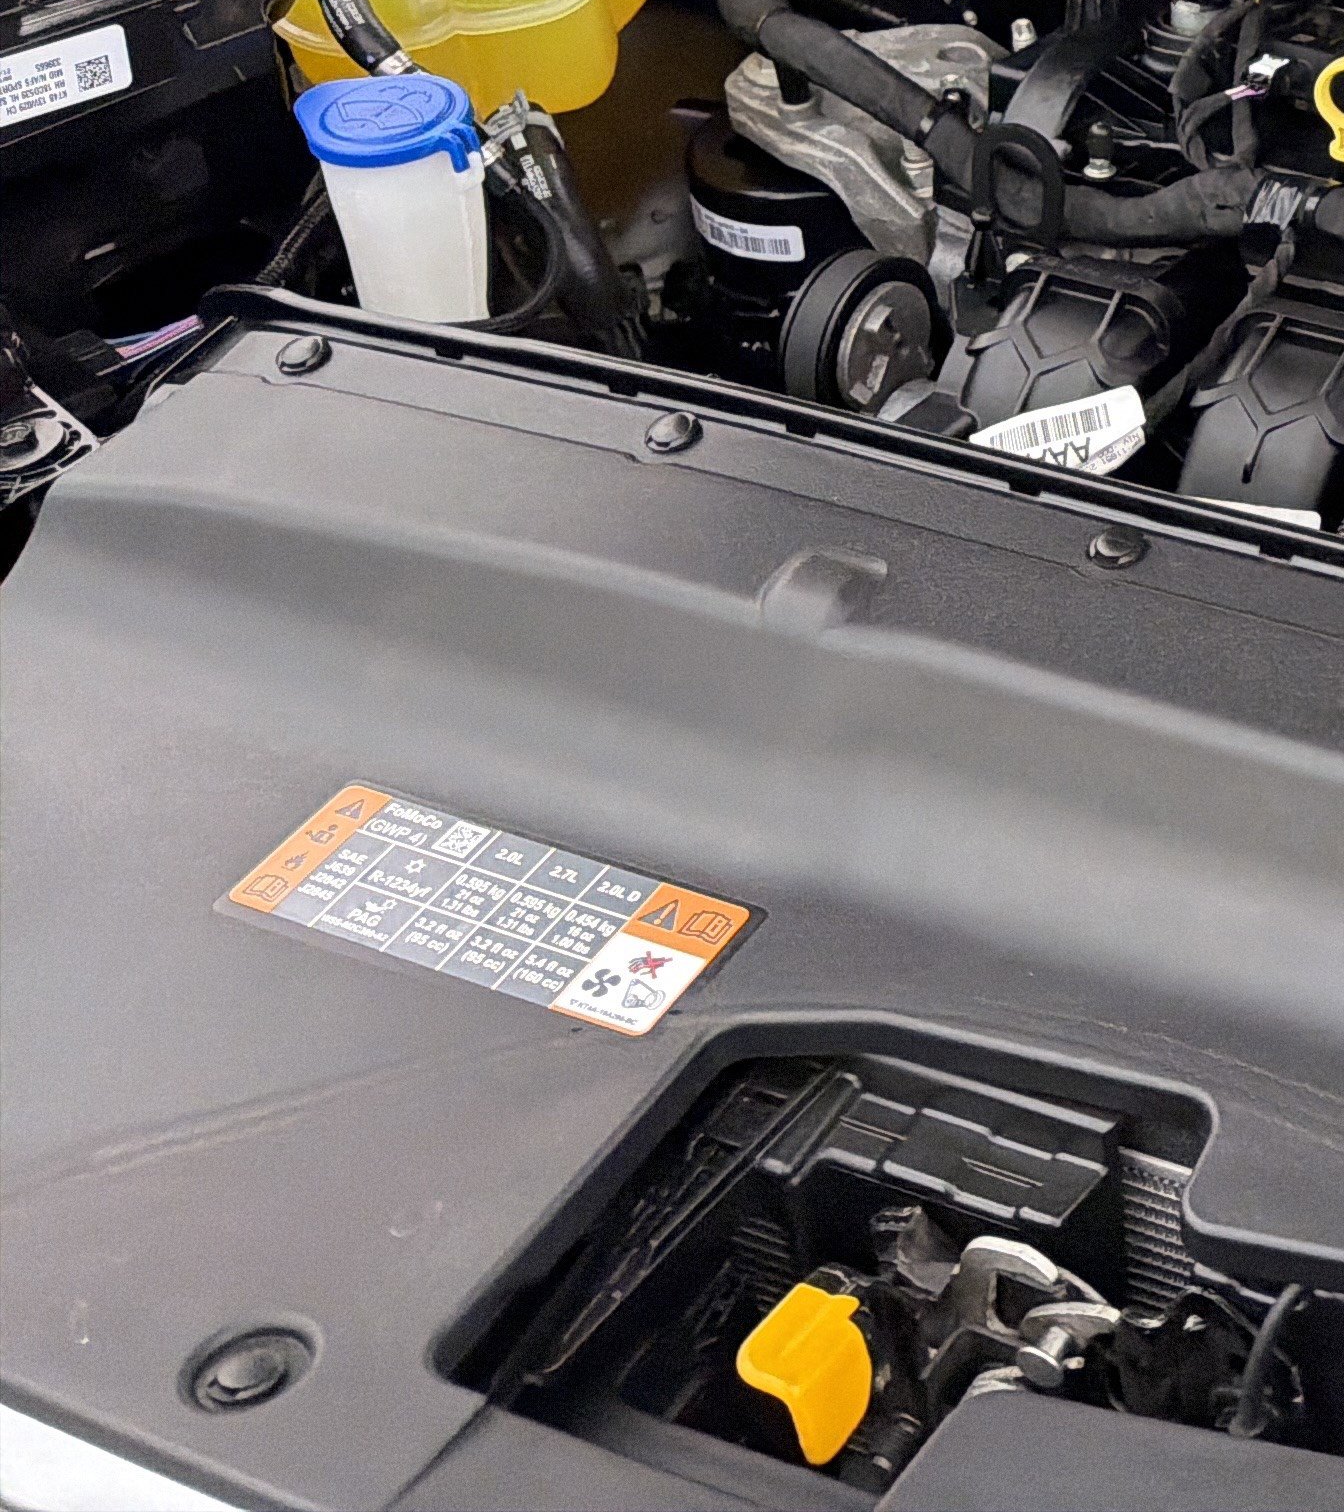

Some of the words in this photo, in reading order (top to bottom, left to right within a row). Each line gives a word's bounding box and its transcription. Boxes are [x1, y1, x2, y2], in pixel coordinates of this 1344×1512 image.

[384, 802, 442, 828] FoMoCo
[362, 818, 410, 841] (GWP
[402, 832, 427, 847] 4)
[338, 849, 368, 864] SAE
[494, 848, 523, 865] 2.0L
[368, 869, 431, 897] R-1234yf
[548, 865, 577, 883] 2.7L
[454, 888, 471, 899] 21
[468, 895, 484, 905] oz
[455, 874, 491, 892] 0.595
[487, 884, 506, 900] kg
[596, 881, 624, 898] 2.0L
[626, 890, 641, 902] D
[509, 906, 526, 918] 21
[524, 913, 540, 923] oz
[510, 891, 546, 910] 0.595
[542, 902, 561, 918] kg
[346, 908, 381, 926] PAG
[414, 916, 437, 931] 3.2
[445, 929, 463, 940] oz
[564, 909, 600, 928] 0.454
[597, 920, 616, 936] kg
[404, 931, 429, 944] (95
[426, 939, 449, 954] cc)
[469, 935, 492, 950] 3.2
[500, 948, 518, 959] oz
[579, 931, 595, 942] oz
[460, 949, 485, 964] (95
[482, 958, 505, 972] cc)
[524, 954, 547, 967] 5.4
[555, 966, 573, 977] oz
[512, 967, 543, 983] (160
[541, 978, 564, 992] cc)
